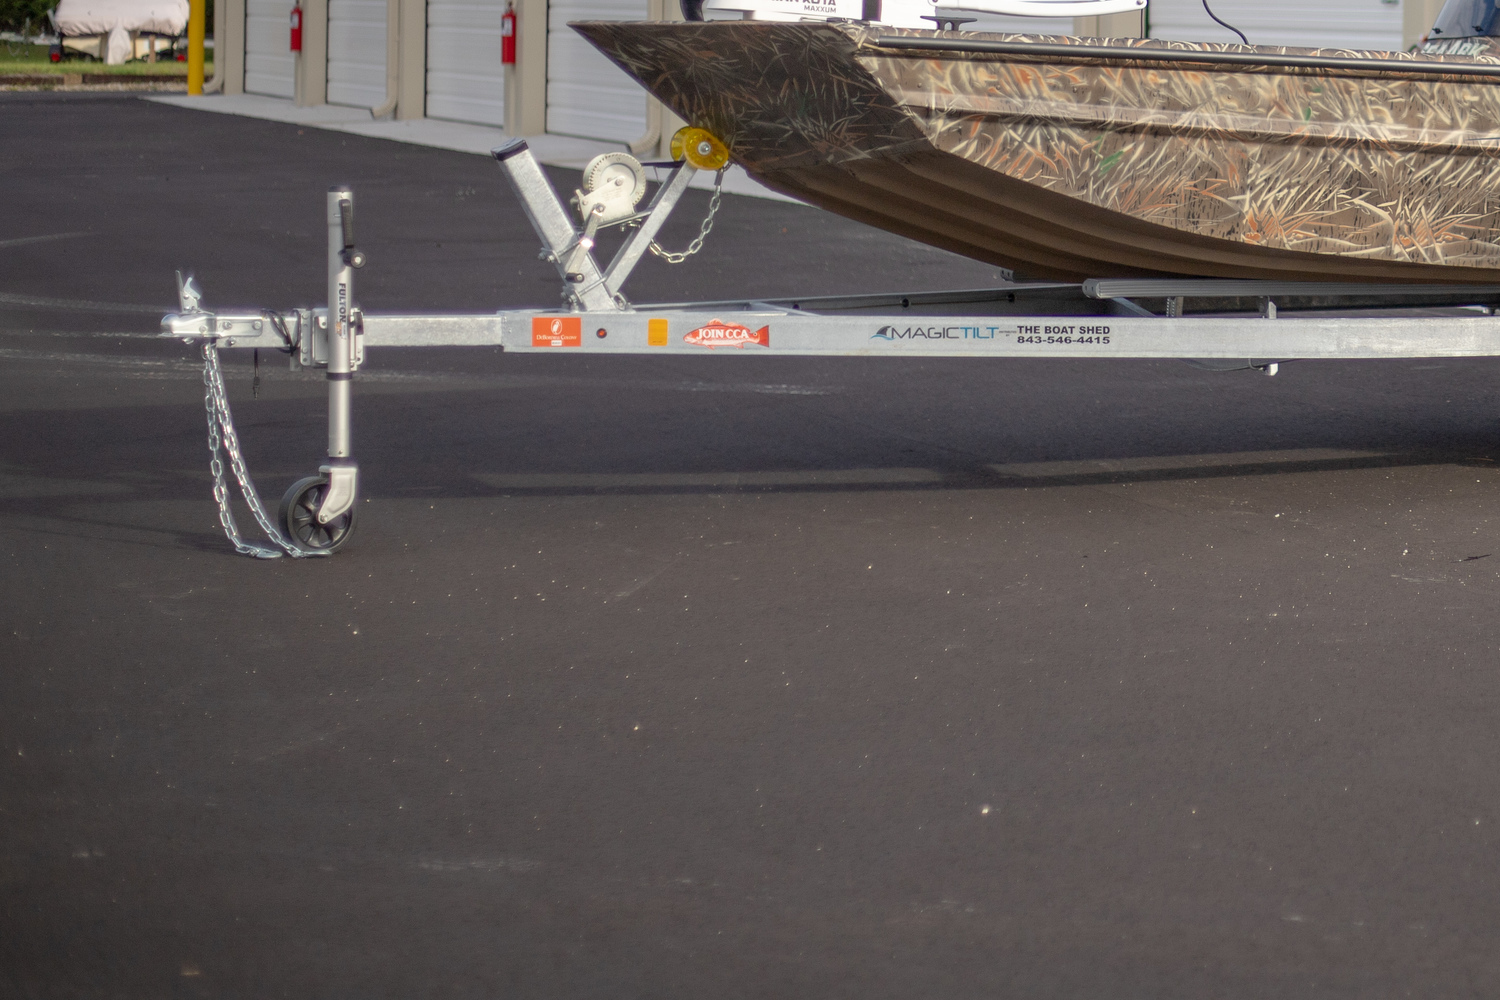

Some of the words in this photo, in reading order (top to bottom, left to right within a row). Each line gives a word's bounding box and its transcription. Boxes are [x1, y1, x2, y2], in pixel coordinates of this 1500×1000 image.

[803, 5, 837, 13] MAXXUM
[696, 329, 723, 340] JOIN
[725, 329, 749, 339] CCA
[892, 327, 999, 339] MAGICTILT
[1017, 326, 1040, 334] THE
[1044, 326, 1075, 334] BOAT
[1079, 326, 1110, 334] SHED
[1017, 336, 1110, 344] 843-546-4415
